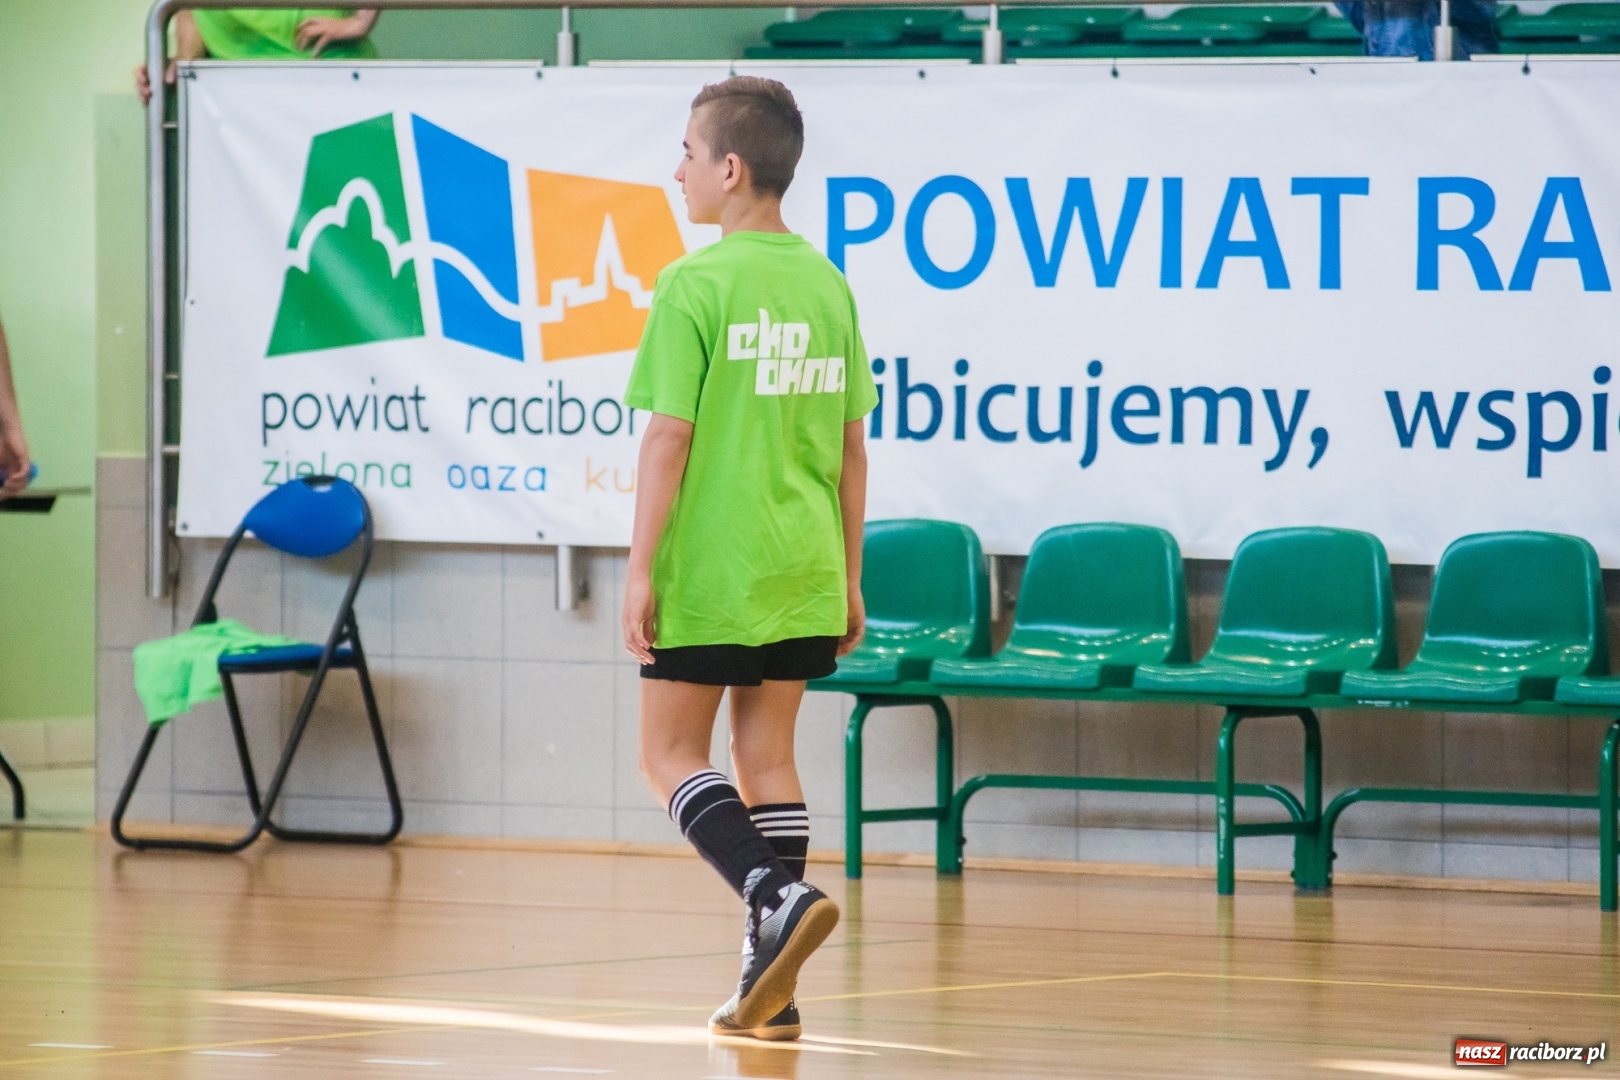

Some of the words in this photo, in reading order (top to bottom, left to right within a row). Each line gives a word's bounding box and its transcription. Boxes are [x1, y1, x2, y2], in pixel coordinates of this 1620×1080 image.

[826, 175, 1369, 290] POWIAT
[262, 376, 429, 447] powiat
[1384, 365, 1620, 478] wspi
[447, 464, 546, 491] oaza
[585, 457, 636, 493] ku
